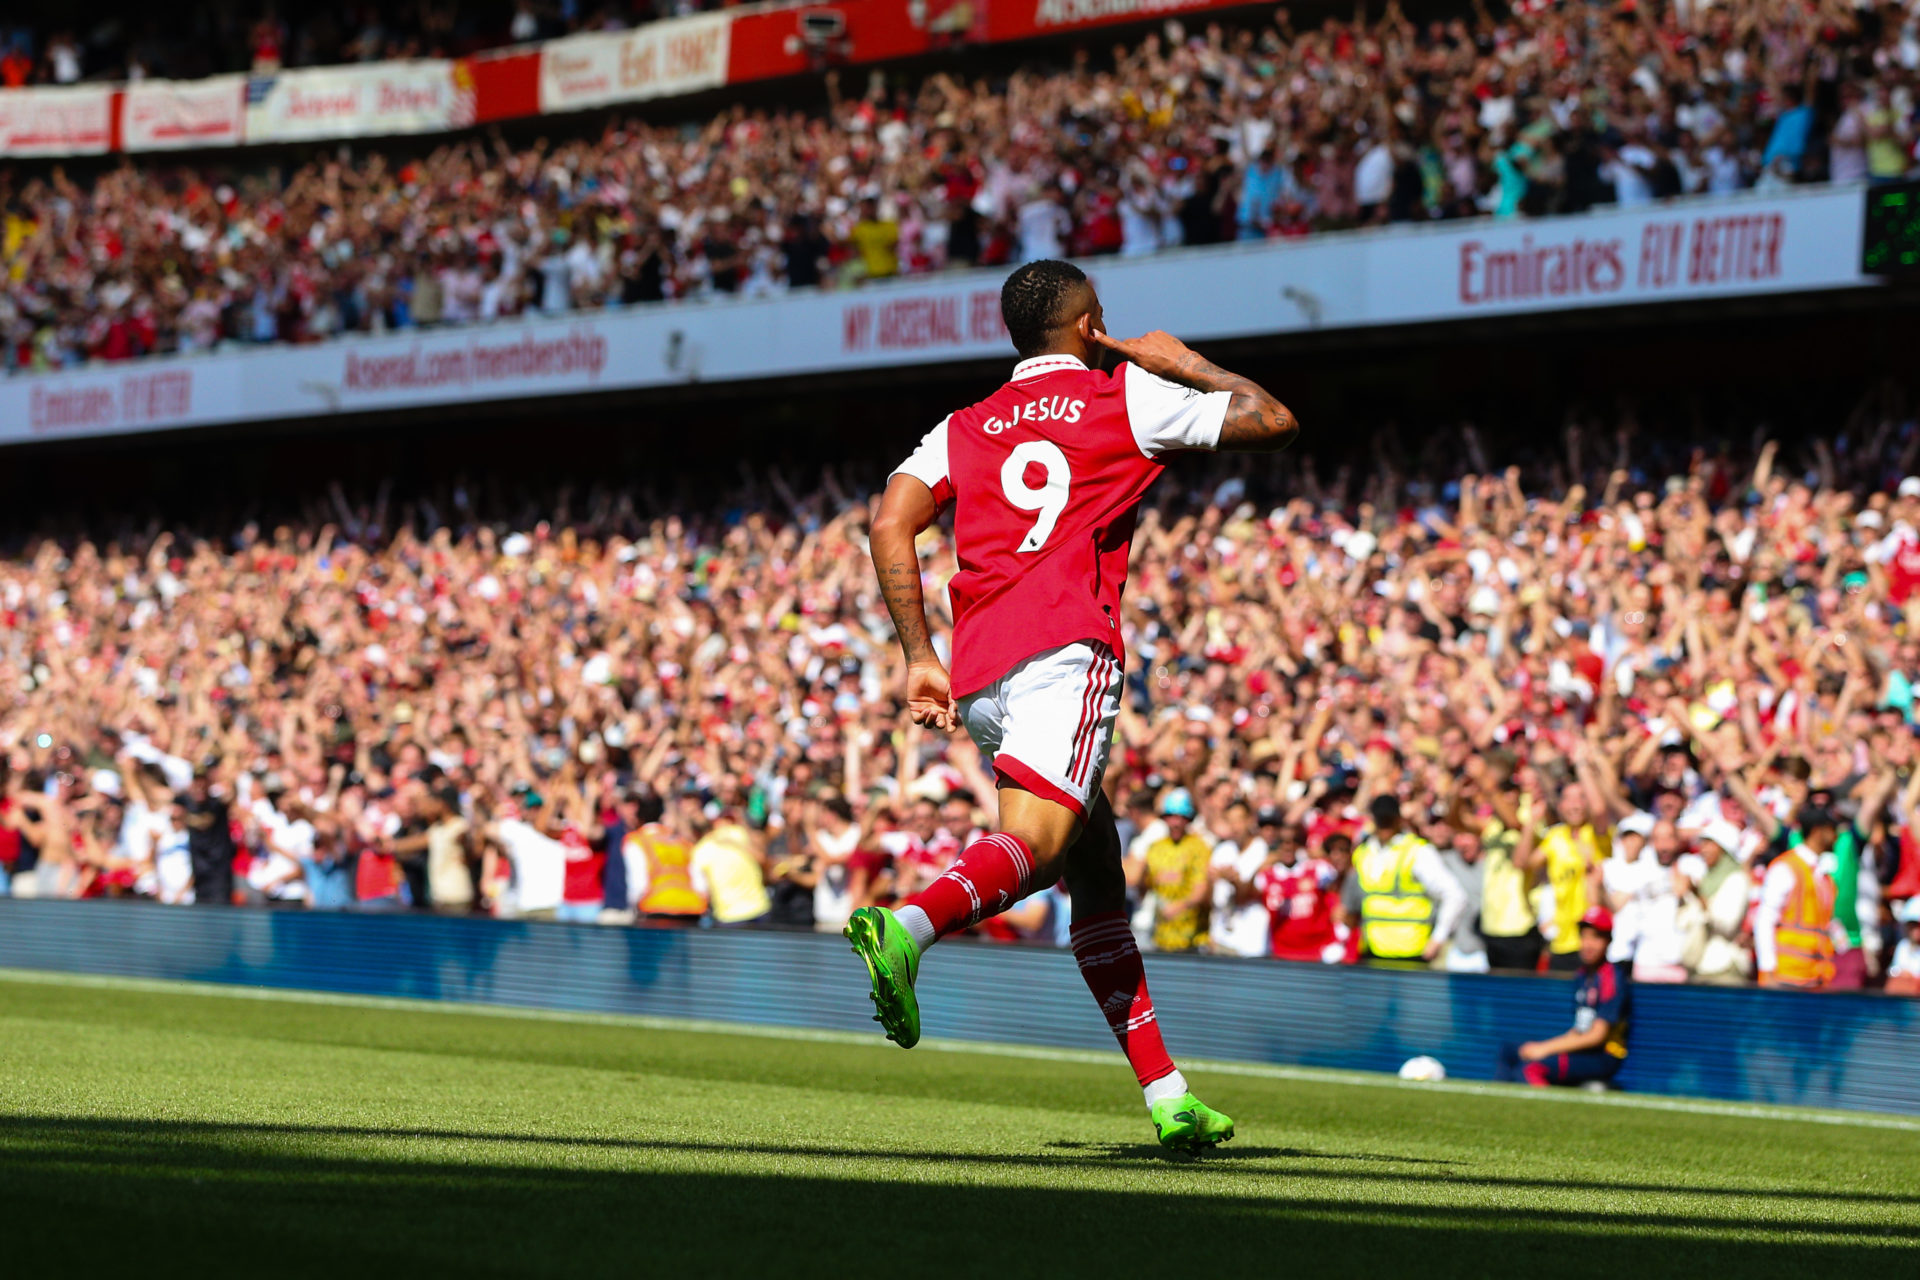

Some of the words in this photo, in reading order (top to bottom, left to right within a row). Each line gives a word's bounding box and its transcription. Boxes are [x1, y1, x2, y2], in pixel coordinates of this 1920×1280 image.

[1458, 236, 1624, 304] Emirates
[1637, 222, 1684, 289] FLY
[1688, 213, 1784, 285] BETTER
[983, 396, 1085, 434] G.JESUS
[1001, 440, 1071, 552] 9
